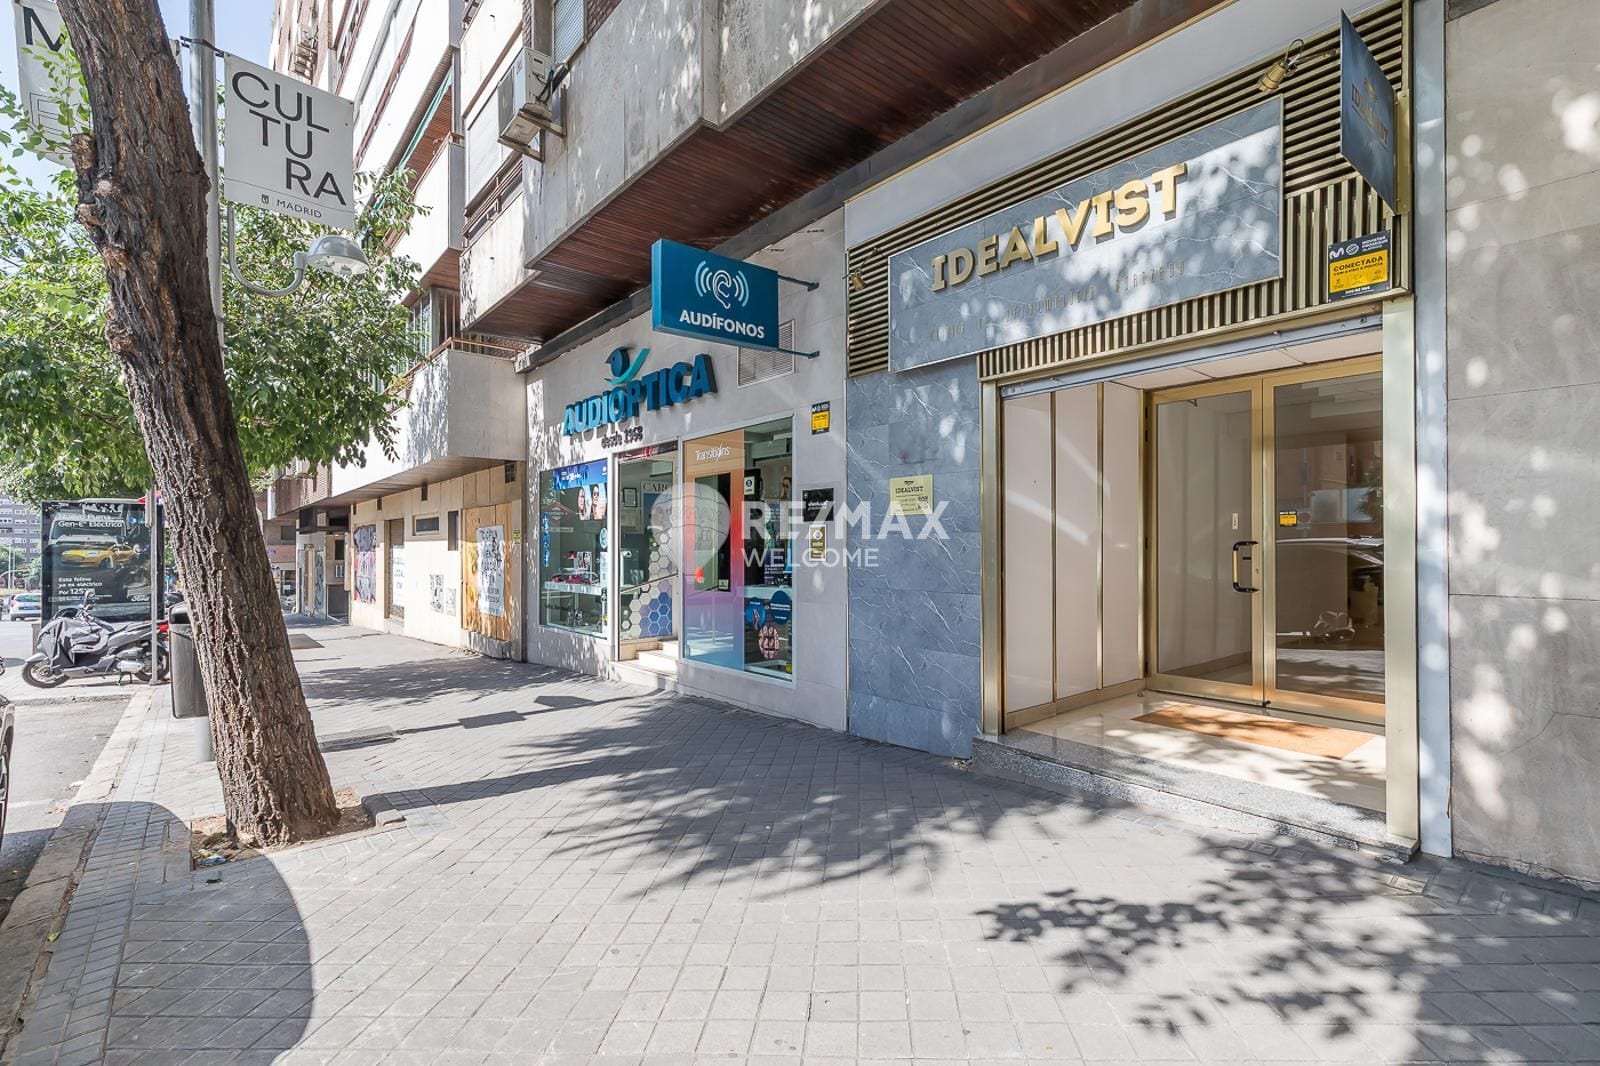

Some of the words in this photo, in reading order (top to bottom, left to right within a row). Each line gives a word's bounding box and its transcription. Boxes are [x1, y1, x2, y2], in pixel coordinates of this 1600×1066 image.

[276, 199, 322, 218] MADRID
[930, 163, 1188, 293] IDEALVIST
[1333, 255, 1384, 272] CONECTADA
[679, 309, 765, 339] AUDÍFONOS
[895, 486, 924, 494] IDEALVIST
